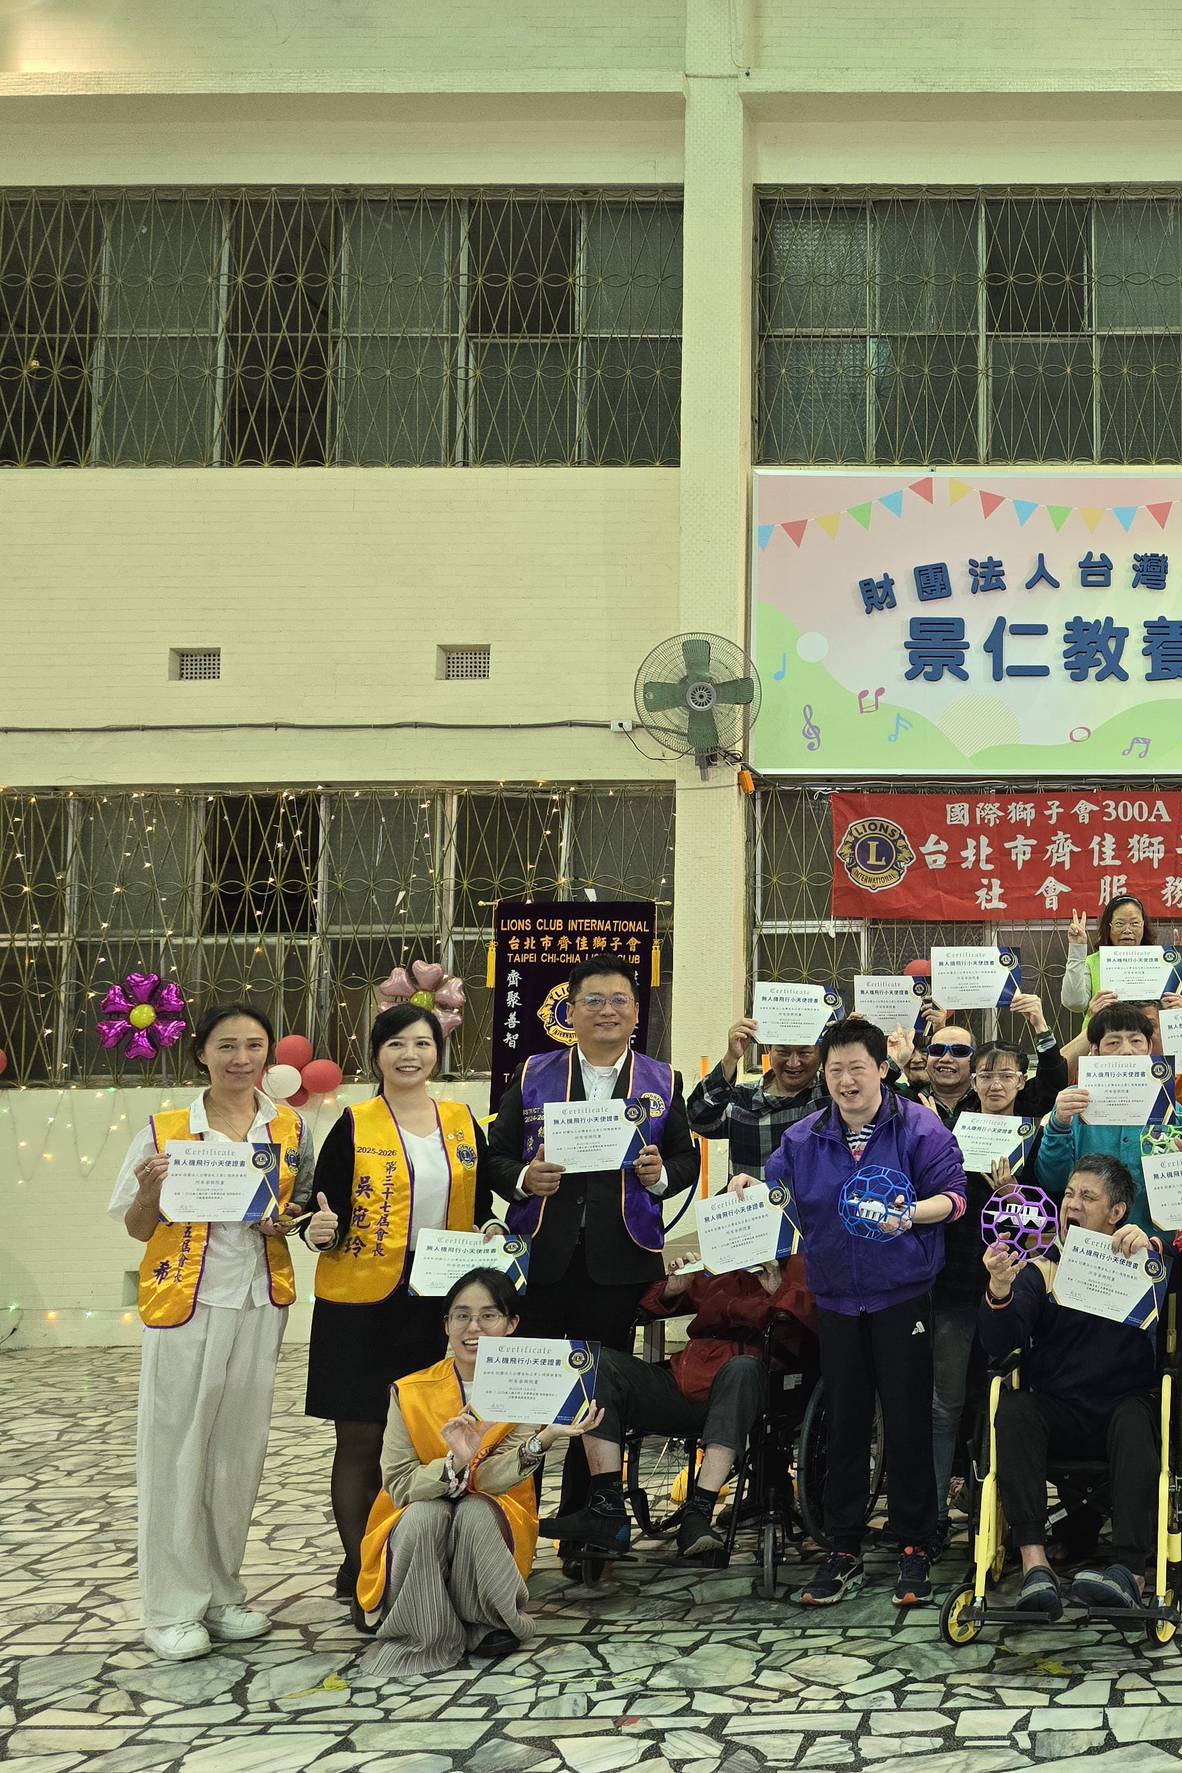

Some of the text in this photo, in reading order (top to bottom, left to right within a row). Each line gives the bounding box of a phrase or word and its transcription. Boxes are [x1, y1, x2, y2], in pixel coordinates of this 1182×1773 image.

[854, 821, 898, 839] LIONS
[867, 840, 886, 866] L
[853, 870, 897, 884] INTERNATIONAL
[500, 918, 650, 932] LIONS CLUB INTERNATIONAL
[508, 935, 641, 953] 台北市齊佳獅子會
[507, 953, 537, 963] TAIPEI
[540, 953, 581, 964] CHI-CHIA
[502, 969, 523, 1049] 齊聚善智
[356, 1146, 398, 1157] 2025-2026
[372, 1160, 398, 1257] 第三十七屆會長
[173, 1222, 193, 1283] 五屆會長
